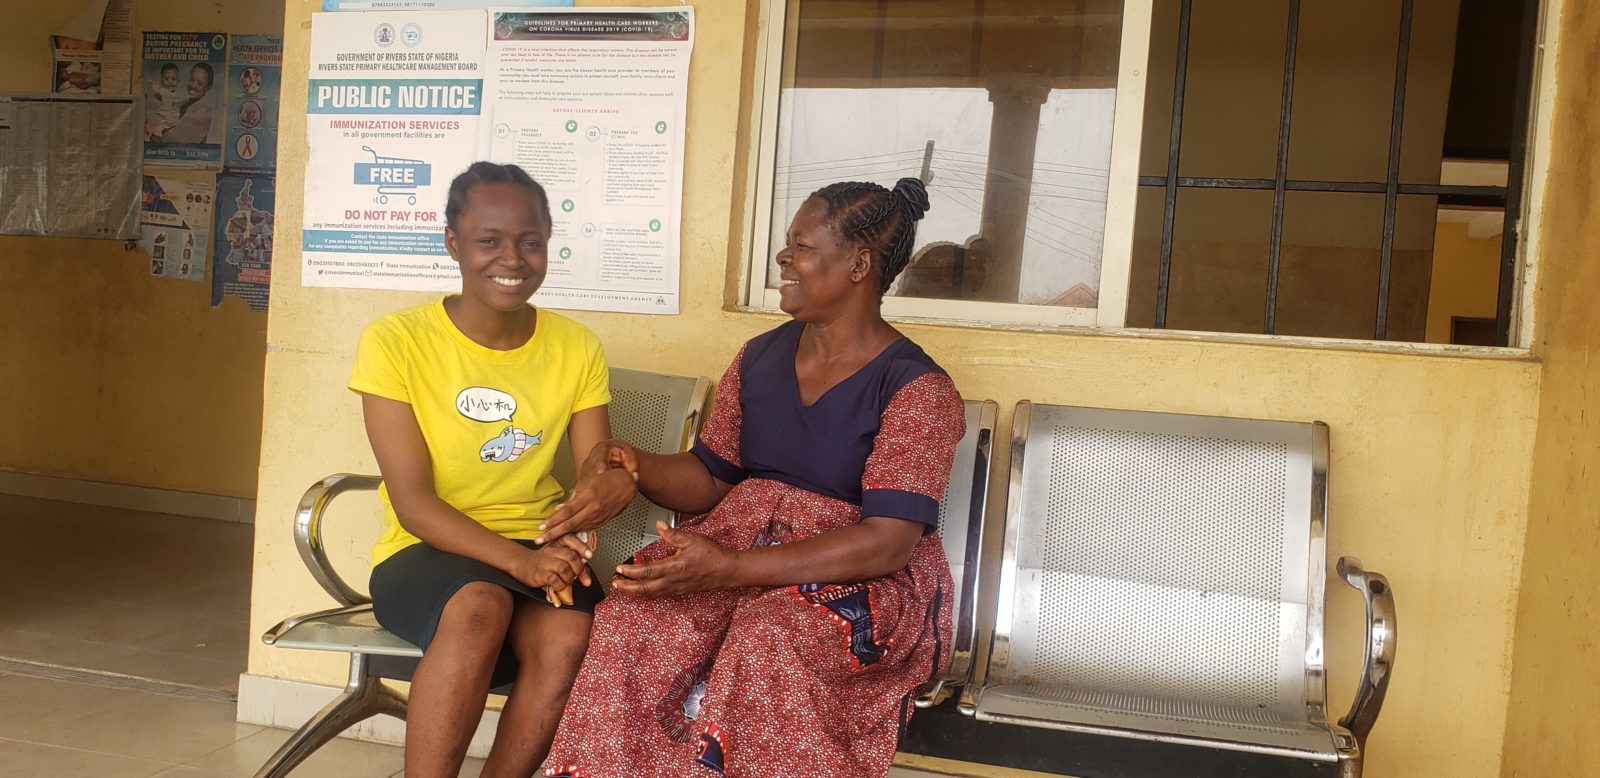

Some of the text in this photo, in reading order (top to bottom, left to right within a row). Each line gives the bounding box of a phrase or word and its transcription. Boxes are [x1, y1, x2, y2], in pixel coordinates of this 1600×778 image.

[336, 53, 458, 61] GOVERNMENT OF RIVERS STATE OF NIGERIA
[318, 86, 476, 108] PUBLIC NOTICE
[330, 120, 460, 130] IMMUNIZATION SERVICES
[370, 168, 414, 183] FREE
[345, 210, 437, 221] DO NOT PAY FOR
[460, 395, 512, 412] 小心机
